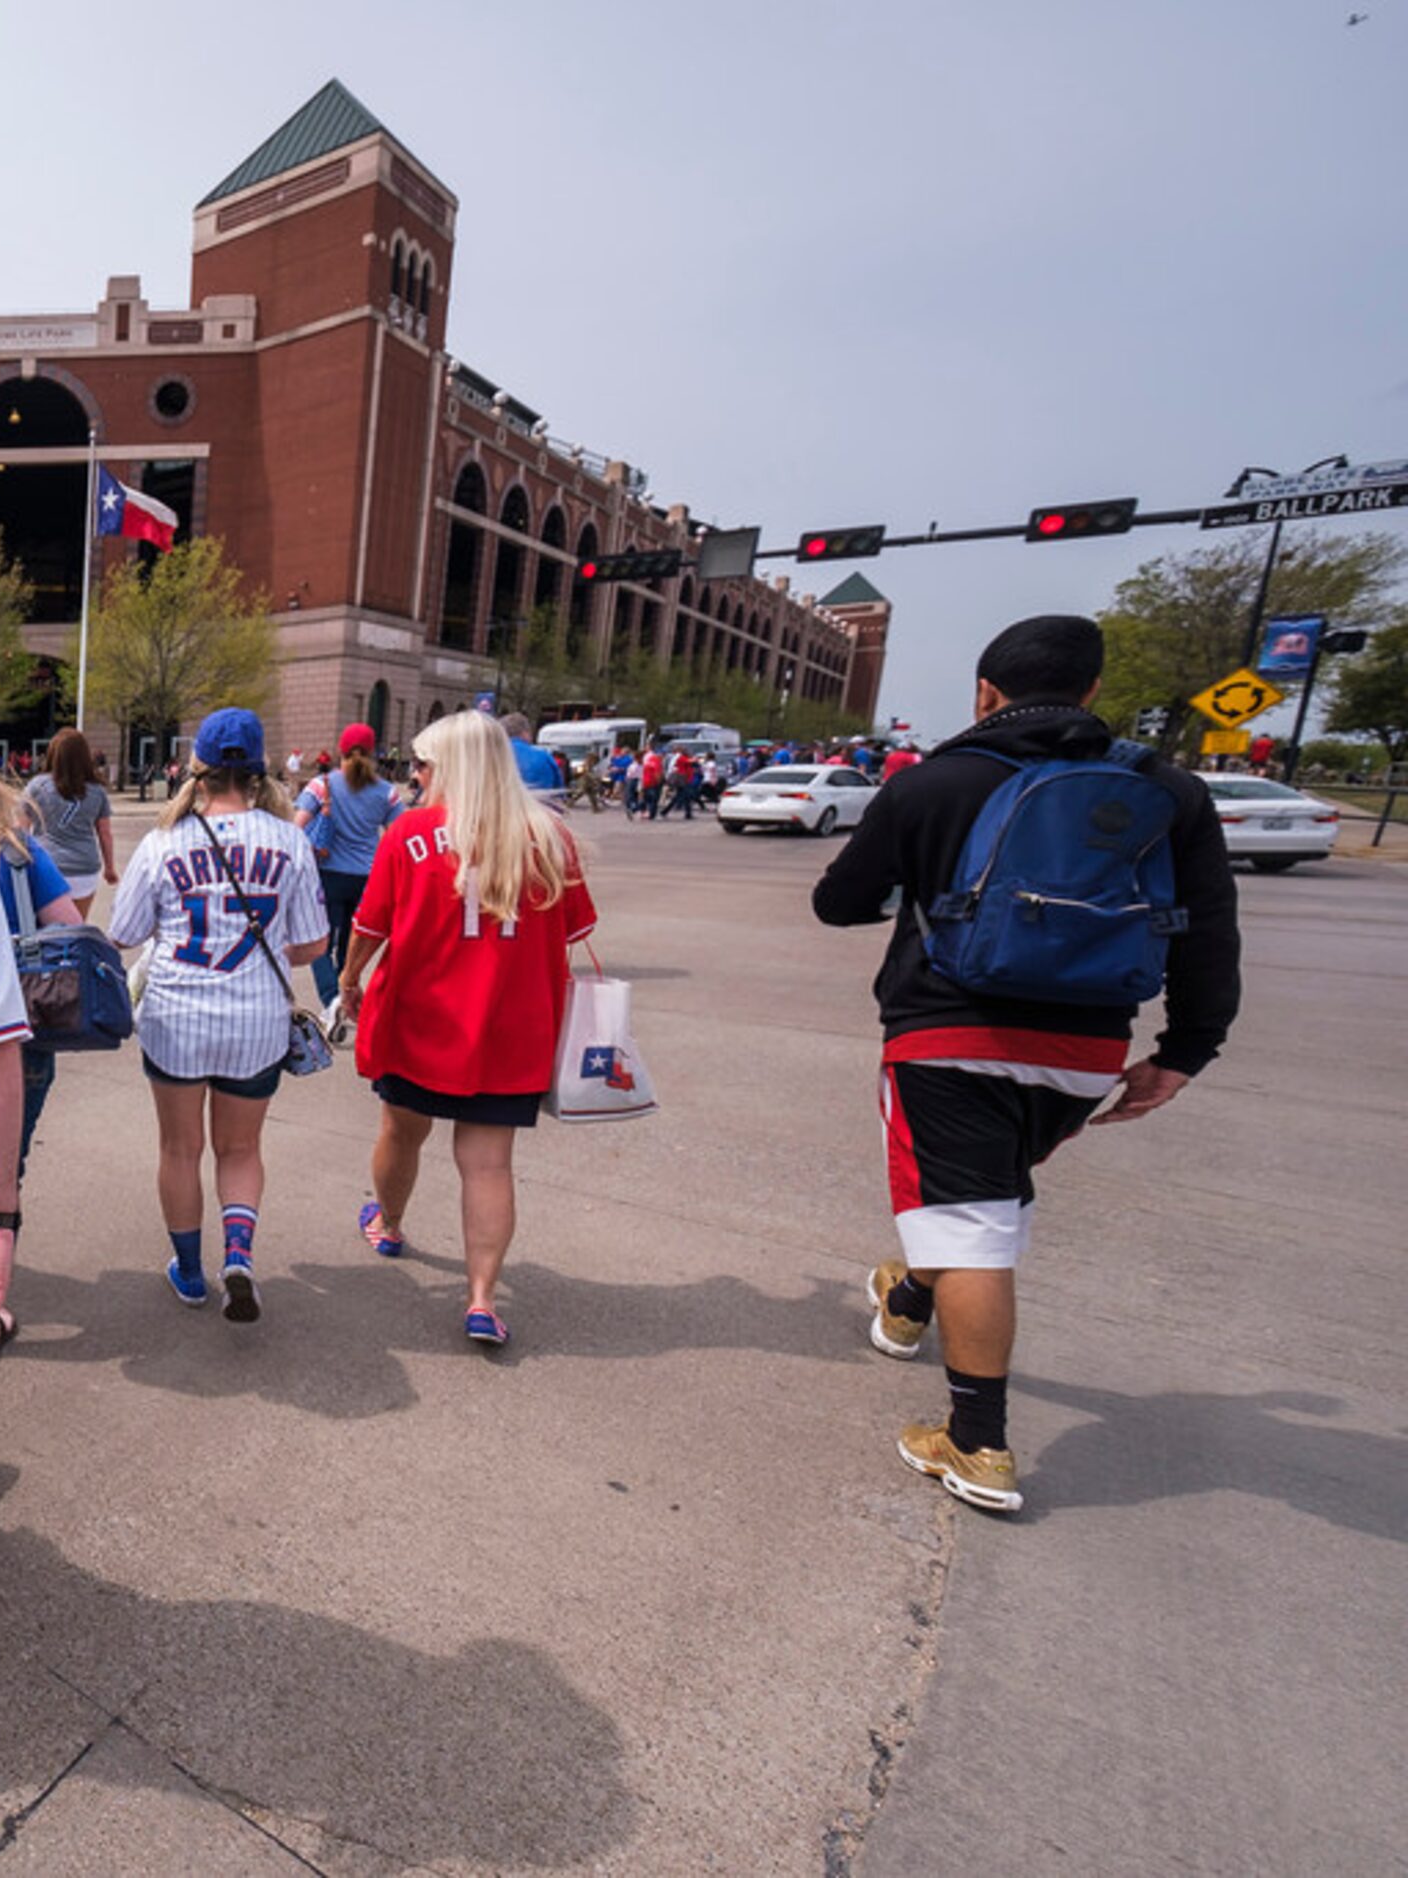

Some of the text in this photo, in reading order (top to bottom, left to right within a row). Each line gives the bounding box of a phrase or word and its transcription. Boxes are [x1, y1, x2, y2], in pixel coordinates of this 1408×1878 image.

[1255, 487, 1393, 521] BALLPARK
[165, 844, 291, 893] BRYANT
[173, 893, 280, 973] 17
